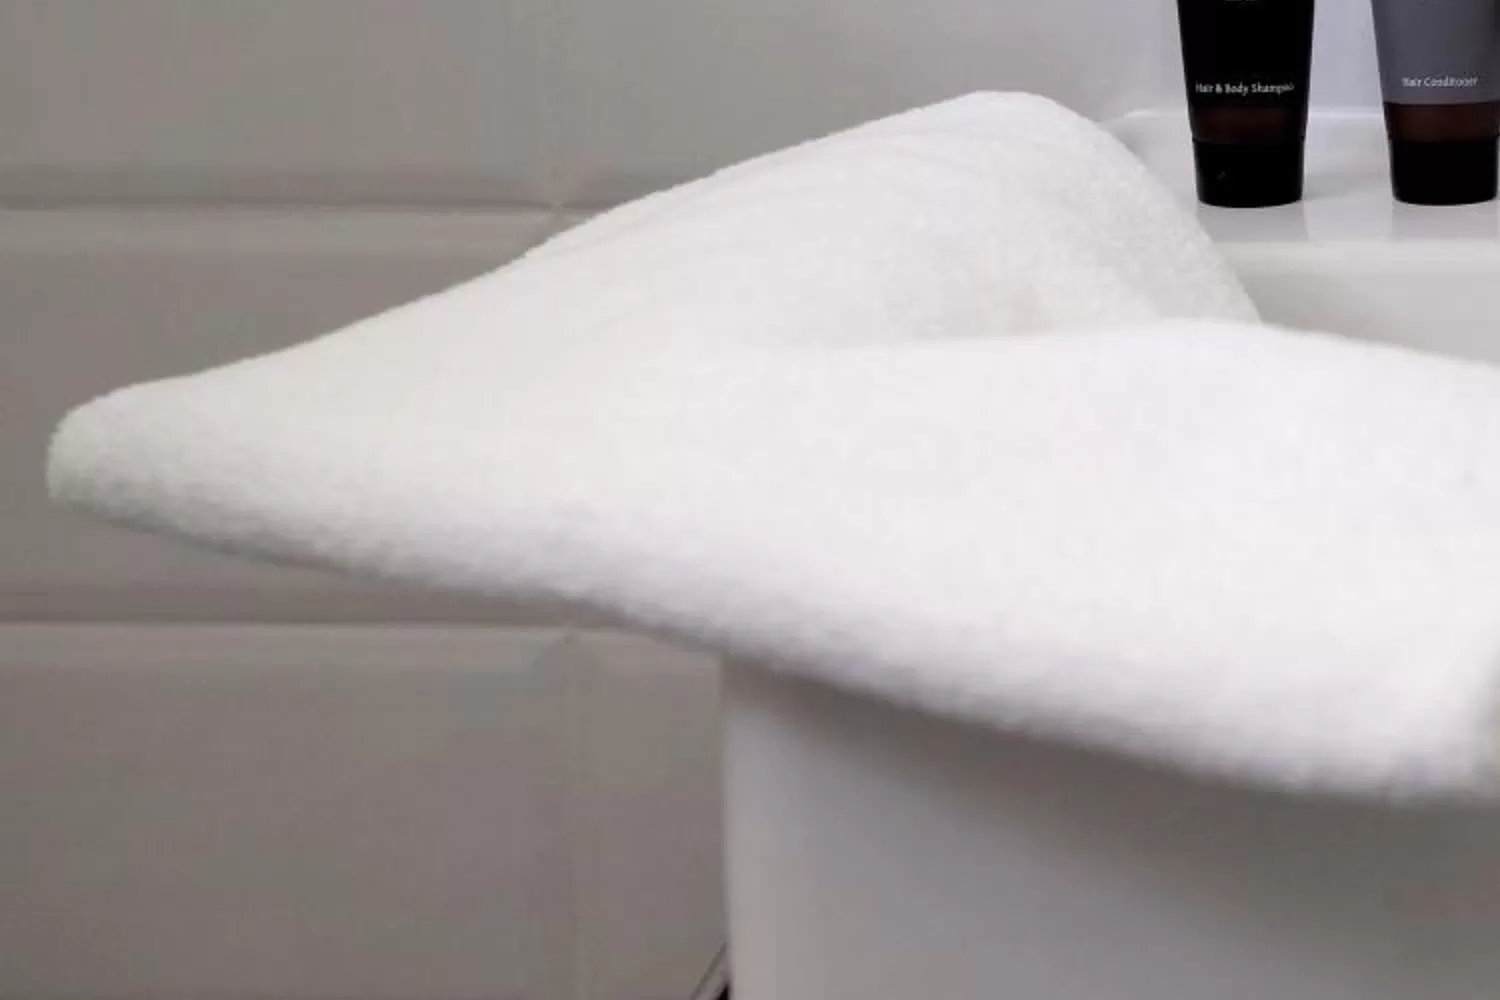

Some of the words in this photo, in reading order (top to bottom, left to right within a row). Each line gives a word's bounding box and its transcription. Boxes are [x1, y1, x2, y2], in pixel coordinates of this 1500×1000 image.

[1402, 76, 1421, 87] Hair
[1195, 82, 1213, 93] Hair
[1215, 83, 1223, 93] &
[1225, 81, 1248, 96] Body
